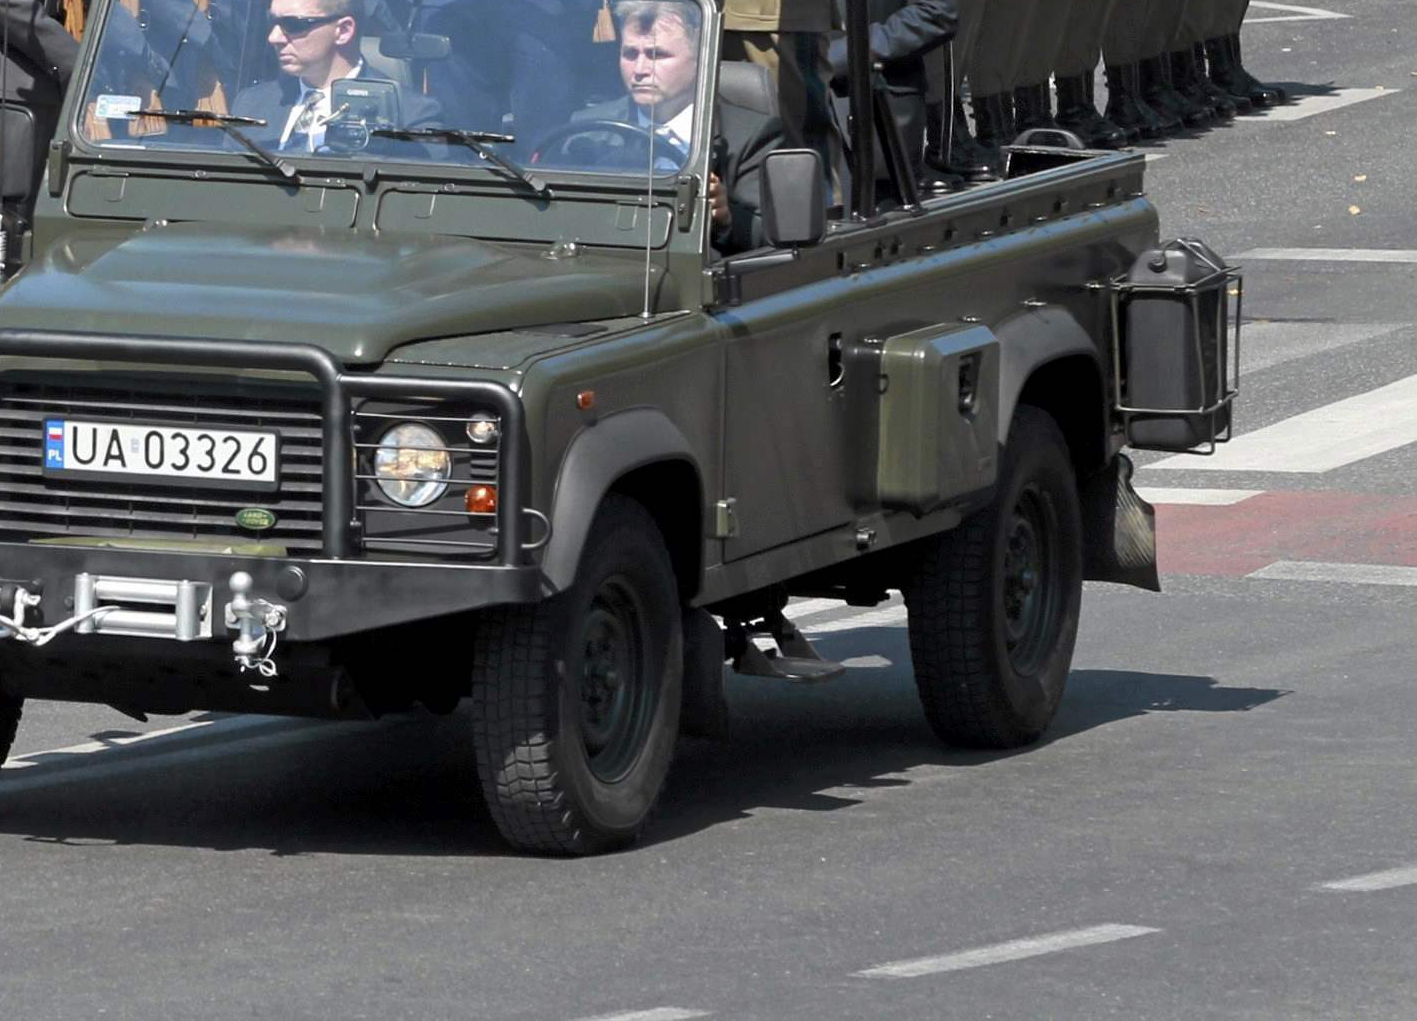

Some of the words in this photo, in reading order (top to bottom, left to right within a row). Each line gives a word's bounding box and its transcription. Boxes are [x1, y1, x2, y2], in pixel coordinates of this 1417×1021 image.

[48, 448, 63, 462] PL
[72, 426, 126, 468] UA
[144, 430, 268, 475] 03326
